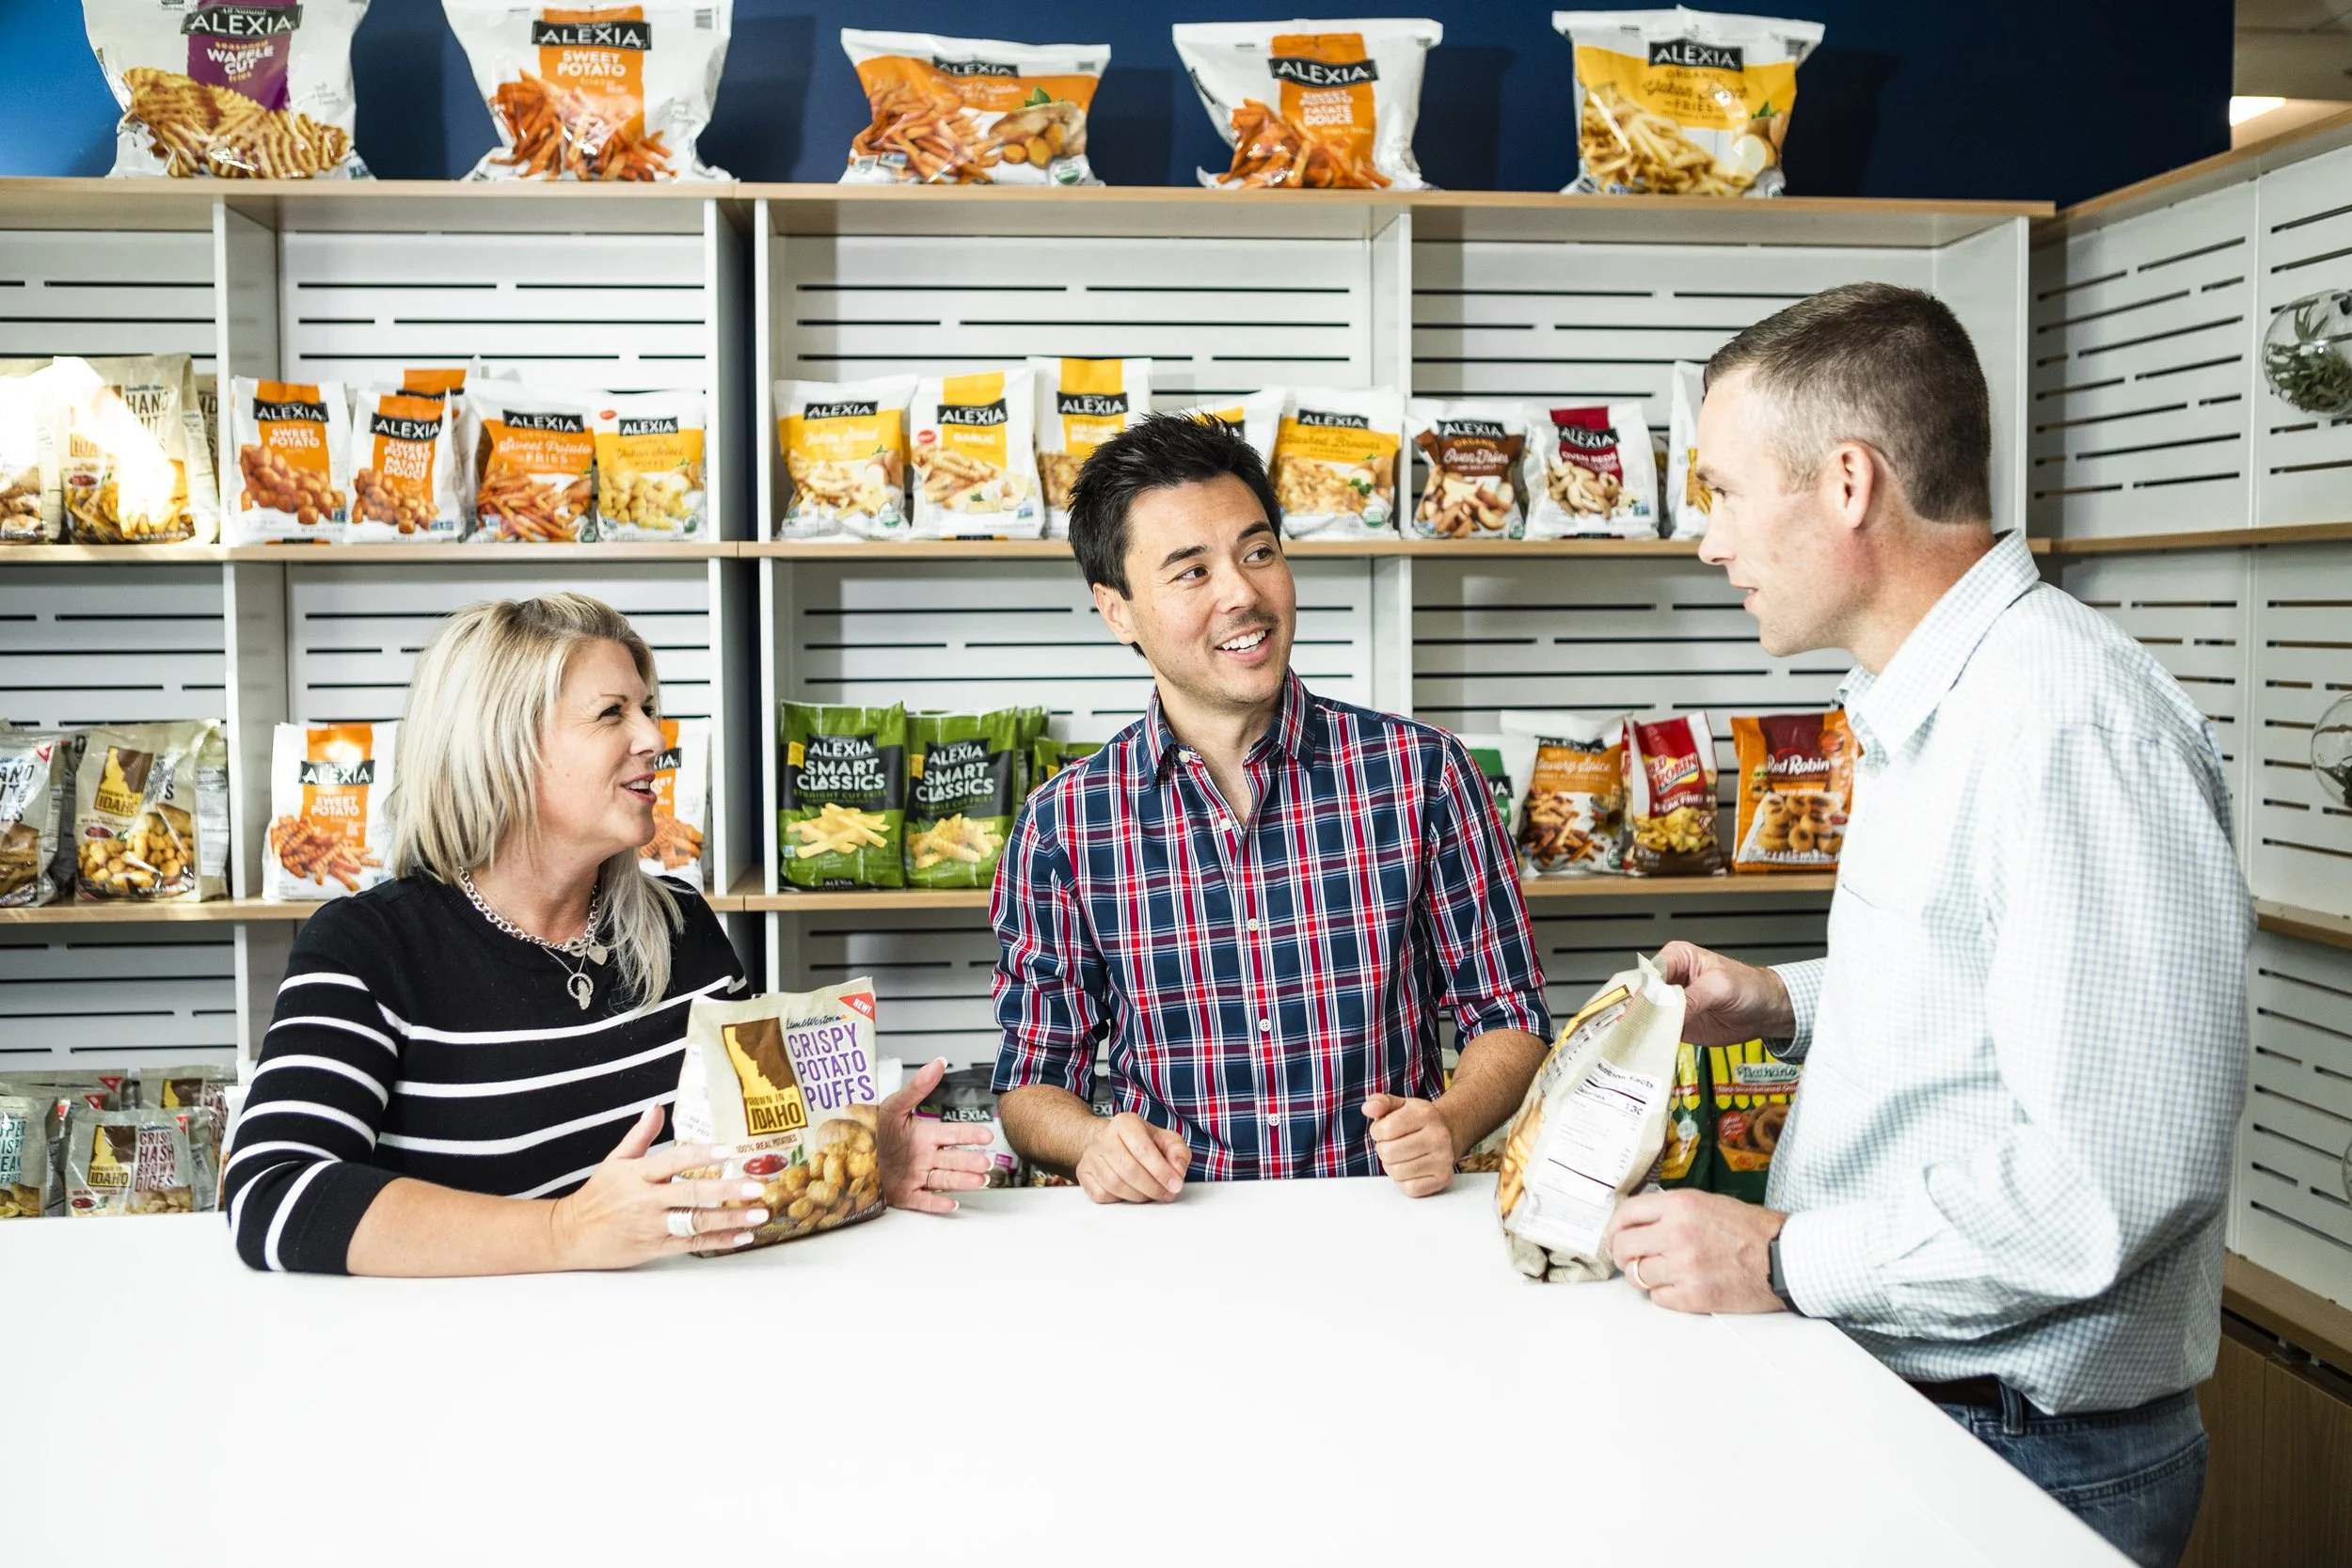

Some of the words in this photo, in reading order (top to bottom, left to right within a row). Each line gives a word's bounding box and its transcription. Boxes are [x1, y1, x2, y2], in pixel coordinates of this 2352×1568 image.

[190, 12, 293, 36] ALEXIA
[541, 27, 643, 47] ALEXIA
[207, 45, 274, 62] WAFFLE
[563, 50, 621, 63] SWEET
[1654, 45, 1735, 67] ALEXIA
[225, 57, 258, 75] CUT
[558, 62, 626, 76] POTATO
[939, 63, 1013, 75] ALEXIA
[1279, 61, 1370, 85] ALEXIA
[1304, 114, 1353, 126] DOUCE
[258, 406, 325, 421] ALEXIA
[807, 404, 871, 420] ALEXIA
[1060, 399, 1123, 414] ALEXIA
[509, 416, 578, 432] ALEXIA
[943, 410, 1006, 426] ALEXIA
[1300, 415, 1364, 428] ALEXIA
[272, 428, 315, 438] SWEET
[376, 420, 440, 439] ALEXIA
[622, 422, 676, 436] ALEXIA
[1443, 422, 1502, 438] ALEXIA
[269, 436, 320, 449] POTATO
[1562, 426, 1614, 450] ALEXIA
[526, 451, 568, 465] FRIES
[810, 741, 873, 757] ALEXIA
[929, 745, 984, 767] ALEXIA
[805, 758, 880, 777] SMART
[1655, 753, 1698, 789] ROBIN
[1768, 754, 1788, 773] Red
[1788, 754, 1830, 775] Robin
[0, 765, 34, 784] AND
[303, 766, 371, 784] ALEXIA
[796, 773, 885, 791] CLASSICS
[924, 762, 989, 786] SMART
[915, 778, 994, 803] CLASSICS
[310, 804, 359, 817] POTATO
[852, 1000, 872, 1016] NEW!
[787, 1022, 857, 1059] CRISPY
[797, 1049, 866, 1083] POTATO
[804, 1075, 875, 1112] PUFFS
[752, 1101, 801, 1131] IDAHO
[943, 1109, 990, 1122] ALEXIA
[756, 1139, 772, 1150] REAL
[772, 1134, 798, 1148] POTATOES
[139, 1145, 176, 1163] HASH
[90, 1171, 129, 1185] IDAHO
